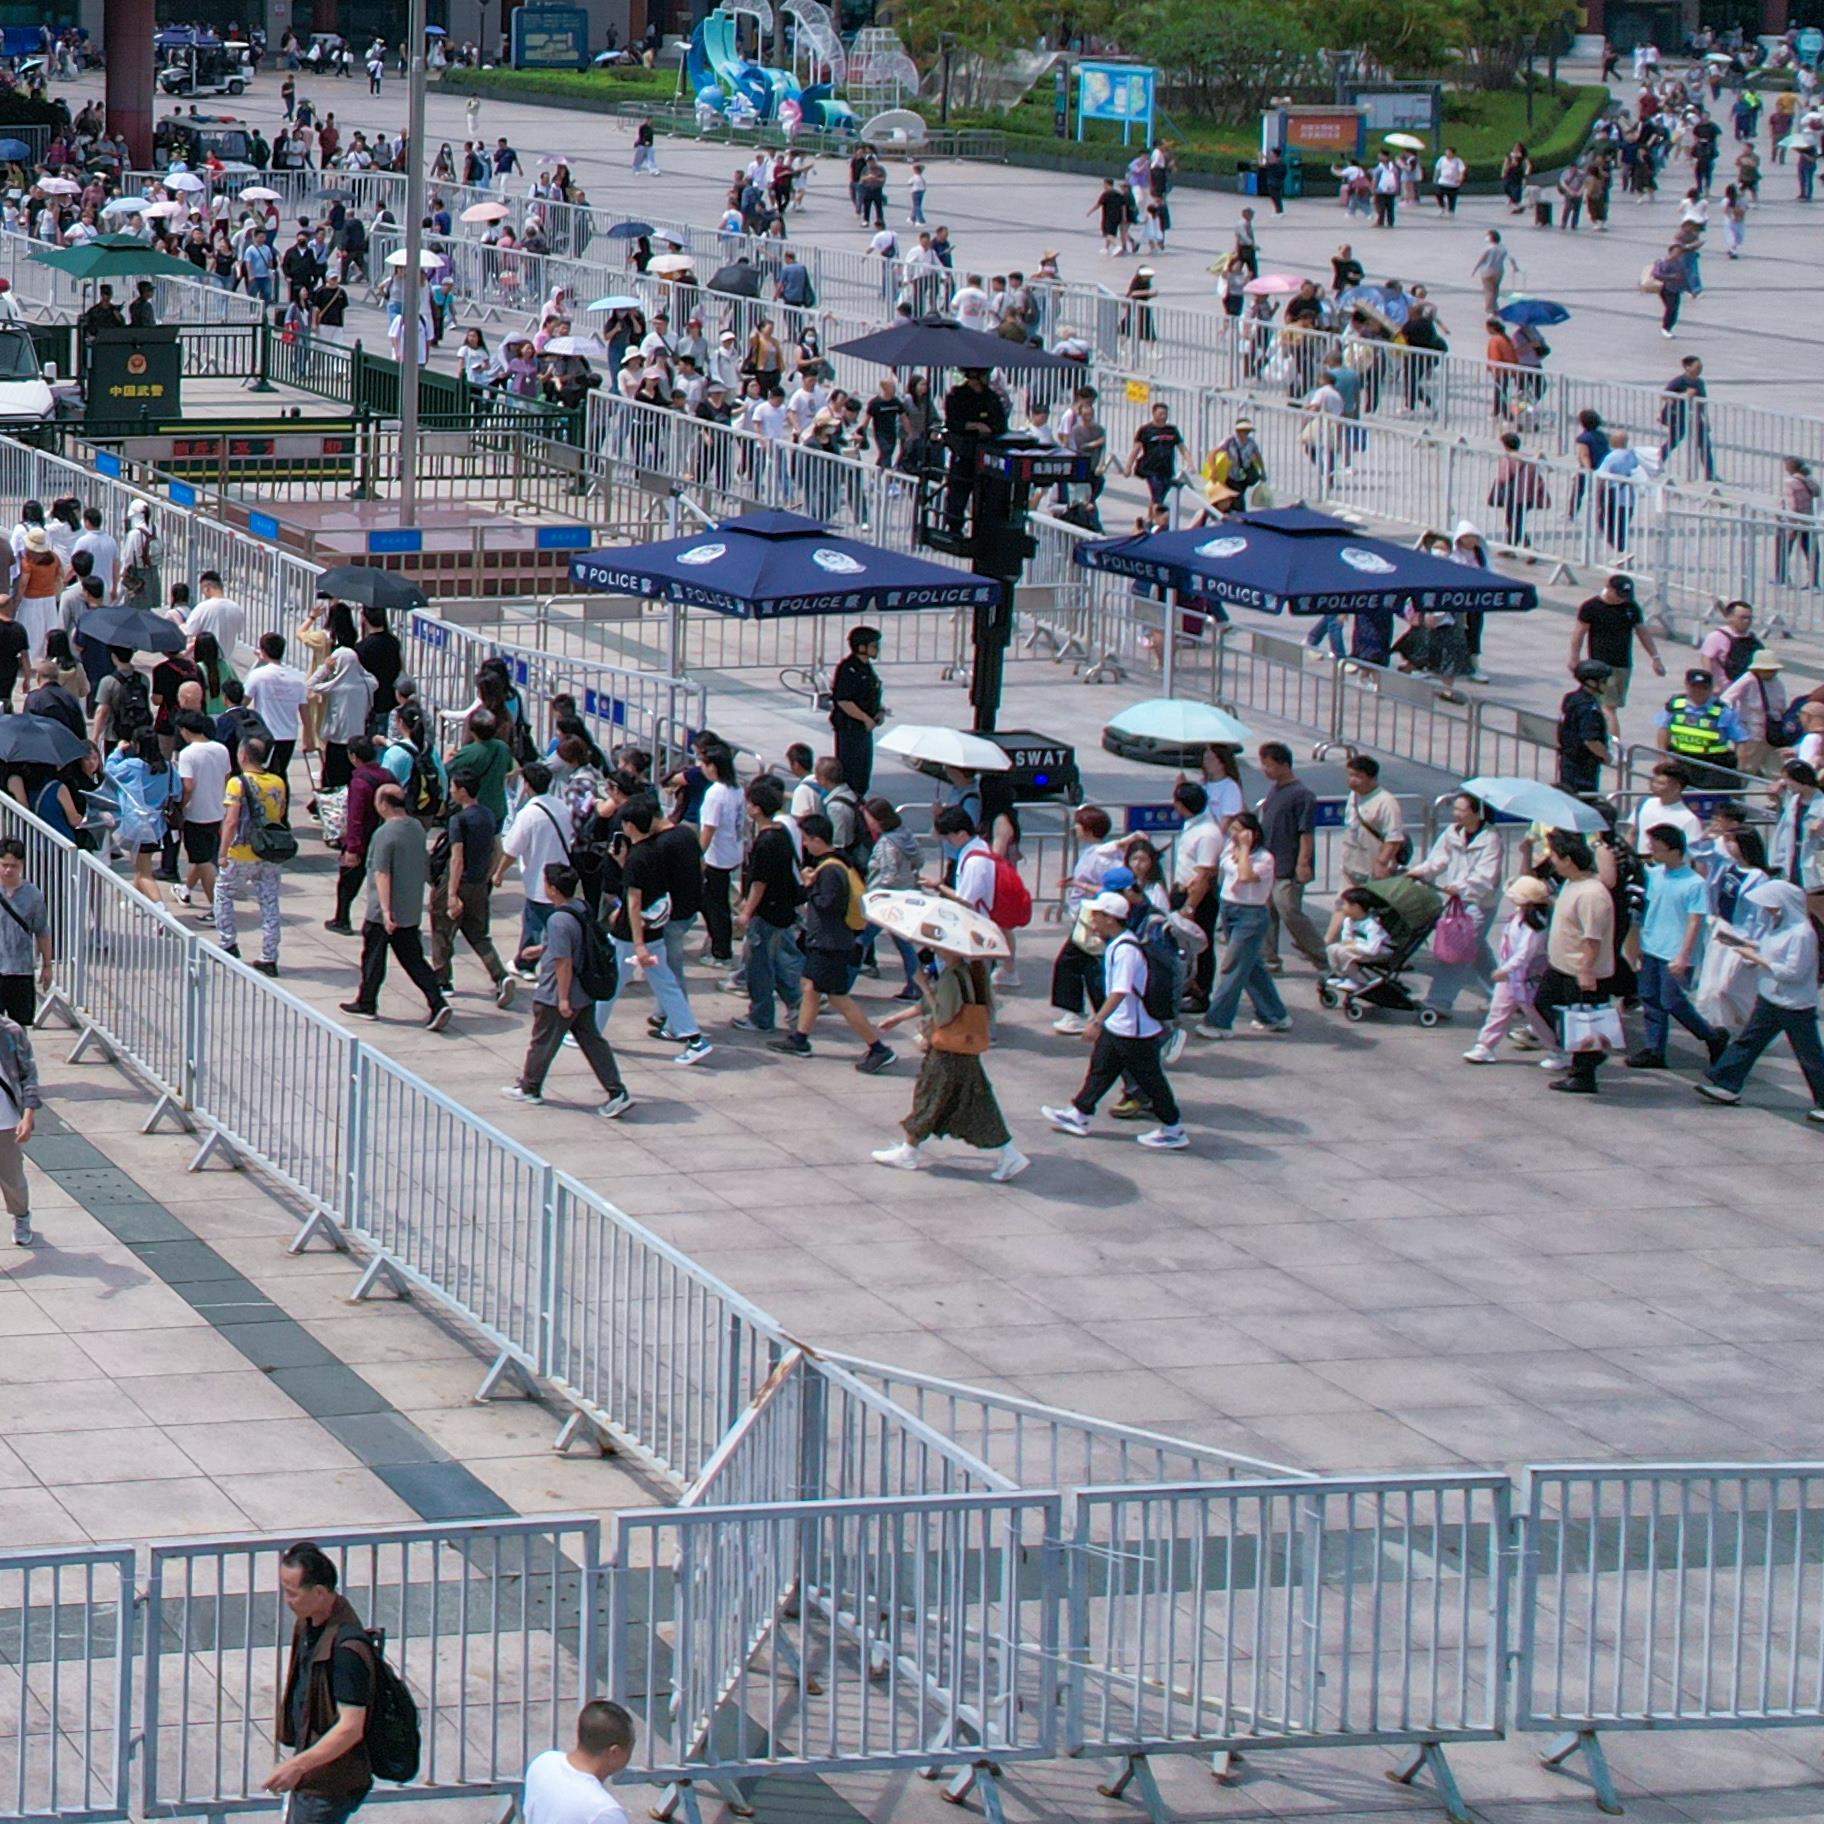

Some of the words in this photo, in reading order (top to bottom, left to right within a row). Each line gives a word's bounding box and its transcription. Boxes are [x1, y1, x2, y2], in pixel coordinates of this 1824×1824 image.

[109, 384, 164, 397] 中国武警
[1102, 554, 1156, 577] POLICE
[589, 567, 639, 590] POLICE
[685, 587, 734, 609] POLICE
[906, 588, 972, 604] POLICE
[1207, 580, 1261, 605] POLICE
[1441, 592, 1505, 607] POLICE
[778, 596, 841, 612] POLICE
[1316, 594, 1379, 609] POLICE
[1015, 750, 1067, 767] SWAT
